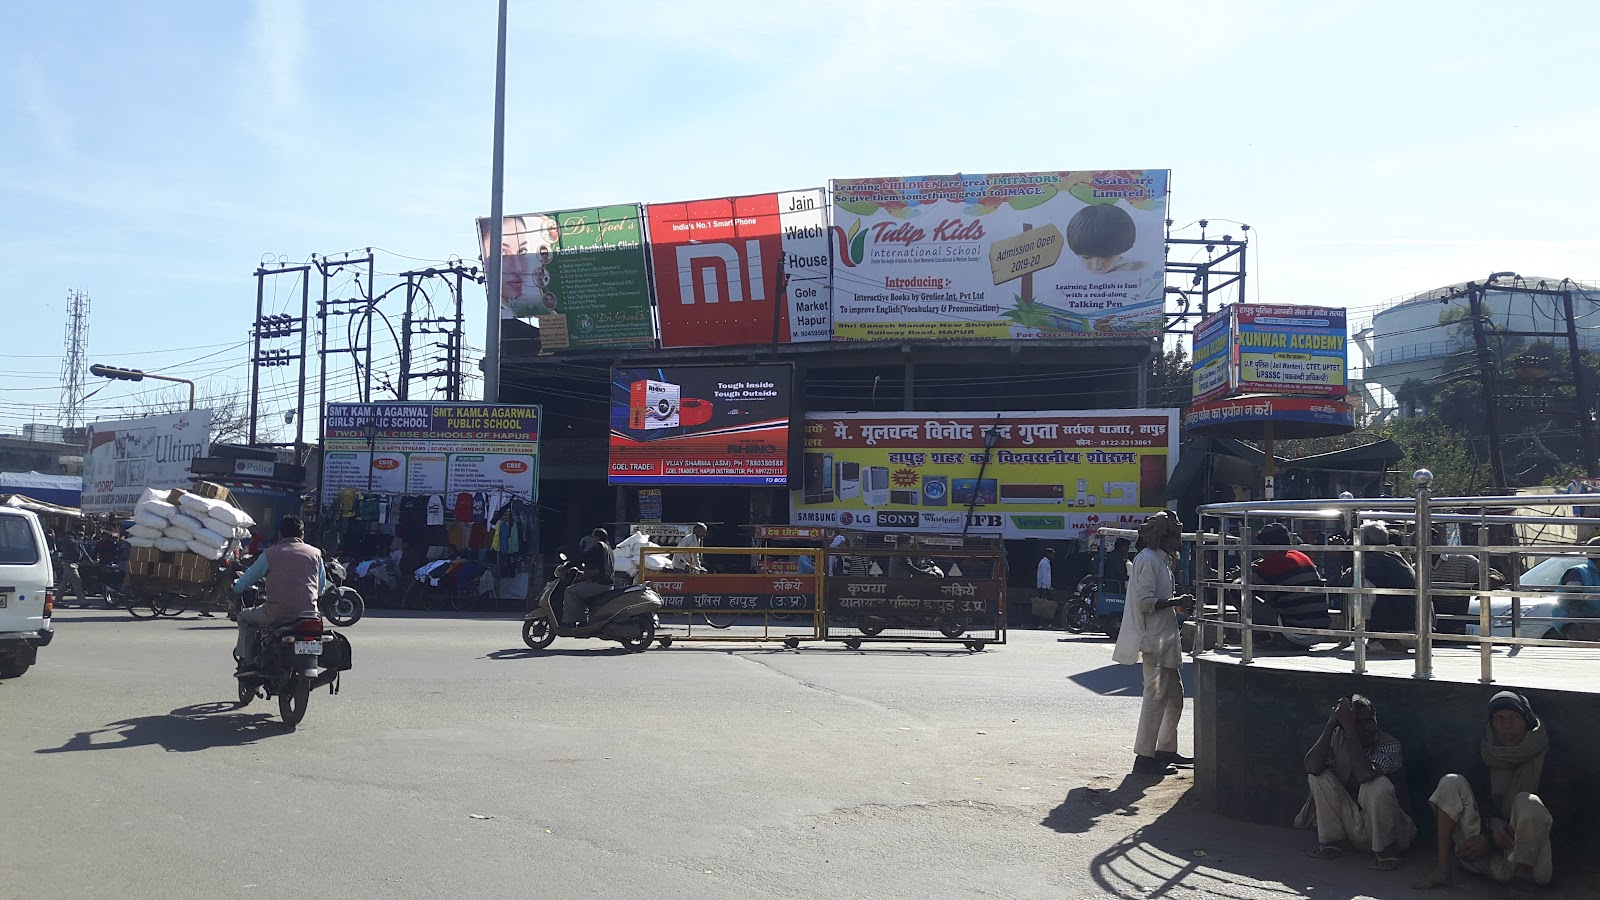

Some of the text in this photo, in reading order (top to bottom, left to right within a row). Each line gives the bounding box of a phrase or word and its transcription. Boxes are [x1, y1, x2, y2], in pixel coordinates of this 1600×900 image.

[835, 183, 880, 192] Learning
[881, 180, 942, 190] CHILDREN
[960, 178, 990, 188] great
[993, 175, 1062, 185] IMITATORS.
[1094, 177, 1130, 186] Seats
[849, 194, 869, 204] give
[871, 193, 899, 201] them
[901, 191, 956, 201] something
[956, 190, 986, 200] great
[989, 189, 1001, 197] to
[1002, 187, 1045, 196] IMAGE.
[1092, 189, 1144, 198] Limited
[789, 196, 814, 211] Jain
[672, 217, 757, 231] India's No.1 Smart Phone
[785, 224, 823, 240] Watch
[871, 218, 986, 247] Tulip Kids
[556, 240, 639, 256] Facial Aesthetics Clinic
[870, 245, 981, 258] International School
[996, 234, 1056, 262] Admission Open
[789, 254, 828, 269] House
[1011, 254, 1041, 273] 2019-20
[885, 276, 944, 289] Introducing
[1056, 283, 1088, 291] Learning
[1089, 283, 1116, 291] English
[795, 287, 817, 298] Gole
[854, 291, 985, 302] Interactive Books by Grolier Int. Pvt Ltd
[796, 301, 829, 312] Market
[848, 306, 875, 315] improve
[948, 304, 1000, 314] Pronunciation)
[1069, 300, 1104, 309] Talking
[797, 315, 826, 326] Hapur
[1239, 331, 1287, 348] KUNWAR
[1290, 334, 1345, 351] ACADEMY
[1322, 364, 1342, 372] UPTET,
[1256, 370, 1280, 380] UPSSSC
[718, 382, 744, 390] Tough
[714, 390, 740, 398] Tough
[329, 406, 428, 417] SMT. KAMA AGARWAL
[434, 408, 536, 418] SMT. KAMLA AGARWAL
[1211, 408, 1220, 420] का
[1222, 403, 1244, 420] प्रयोग
[1245, 405, 1253, 416] न
[328, 417, 428, 428] GIRLS PULIC SCHOOL
[448, 418, 522, 429] PUBLIC SCHOOL
[334, 430, 357, 438] TWO
[360, 430, 390, 438] IAL
[476, 431, 490, 439] OF
[833, 421, 854, 440] मै.
[860, 425, 919, 445] मूलचन्द
[924, 421, 974, 440] विनोद
[1018, 424, 1059, 445] गुप्ता
[1062, 423, 1095, 434] सर्राफा
[1139, 424, 1167, 437] हापुड़
[156, 434, 203, 464] Ultima
[888, 450, 1137, 467] हापुड़ शहर विश्वसनीय शोरूम
[246, 463, 273, 473] Police
[798, 512, 836, 522] SAMSUNG
[856, 515, 871, 523] LG
[878, 515, 917, 524] SONY
[924, 516, 960, 524] Whirlpool
[967, 515, 1002, 527] IFB
[652, 578, 803, 592] कृपया रुकिये
[847, 582, 977, 597] कृपया रुकिये
[694, 594, 758, 609] पुलिस हापुड़
